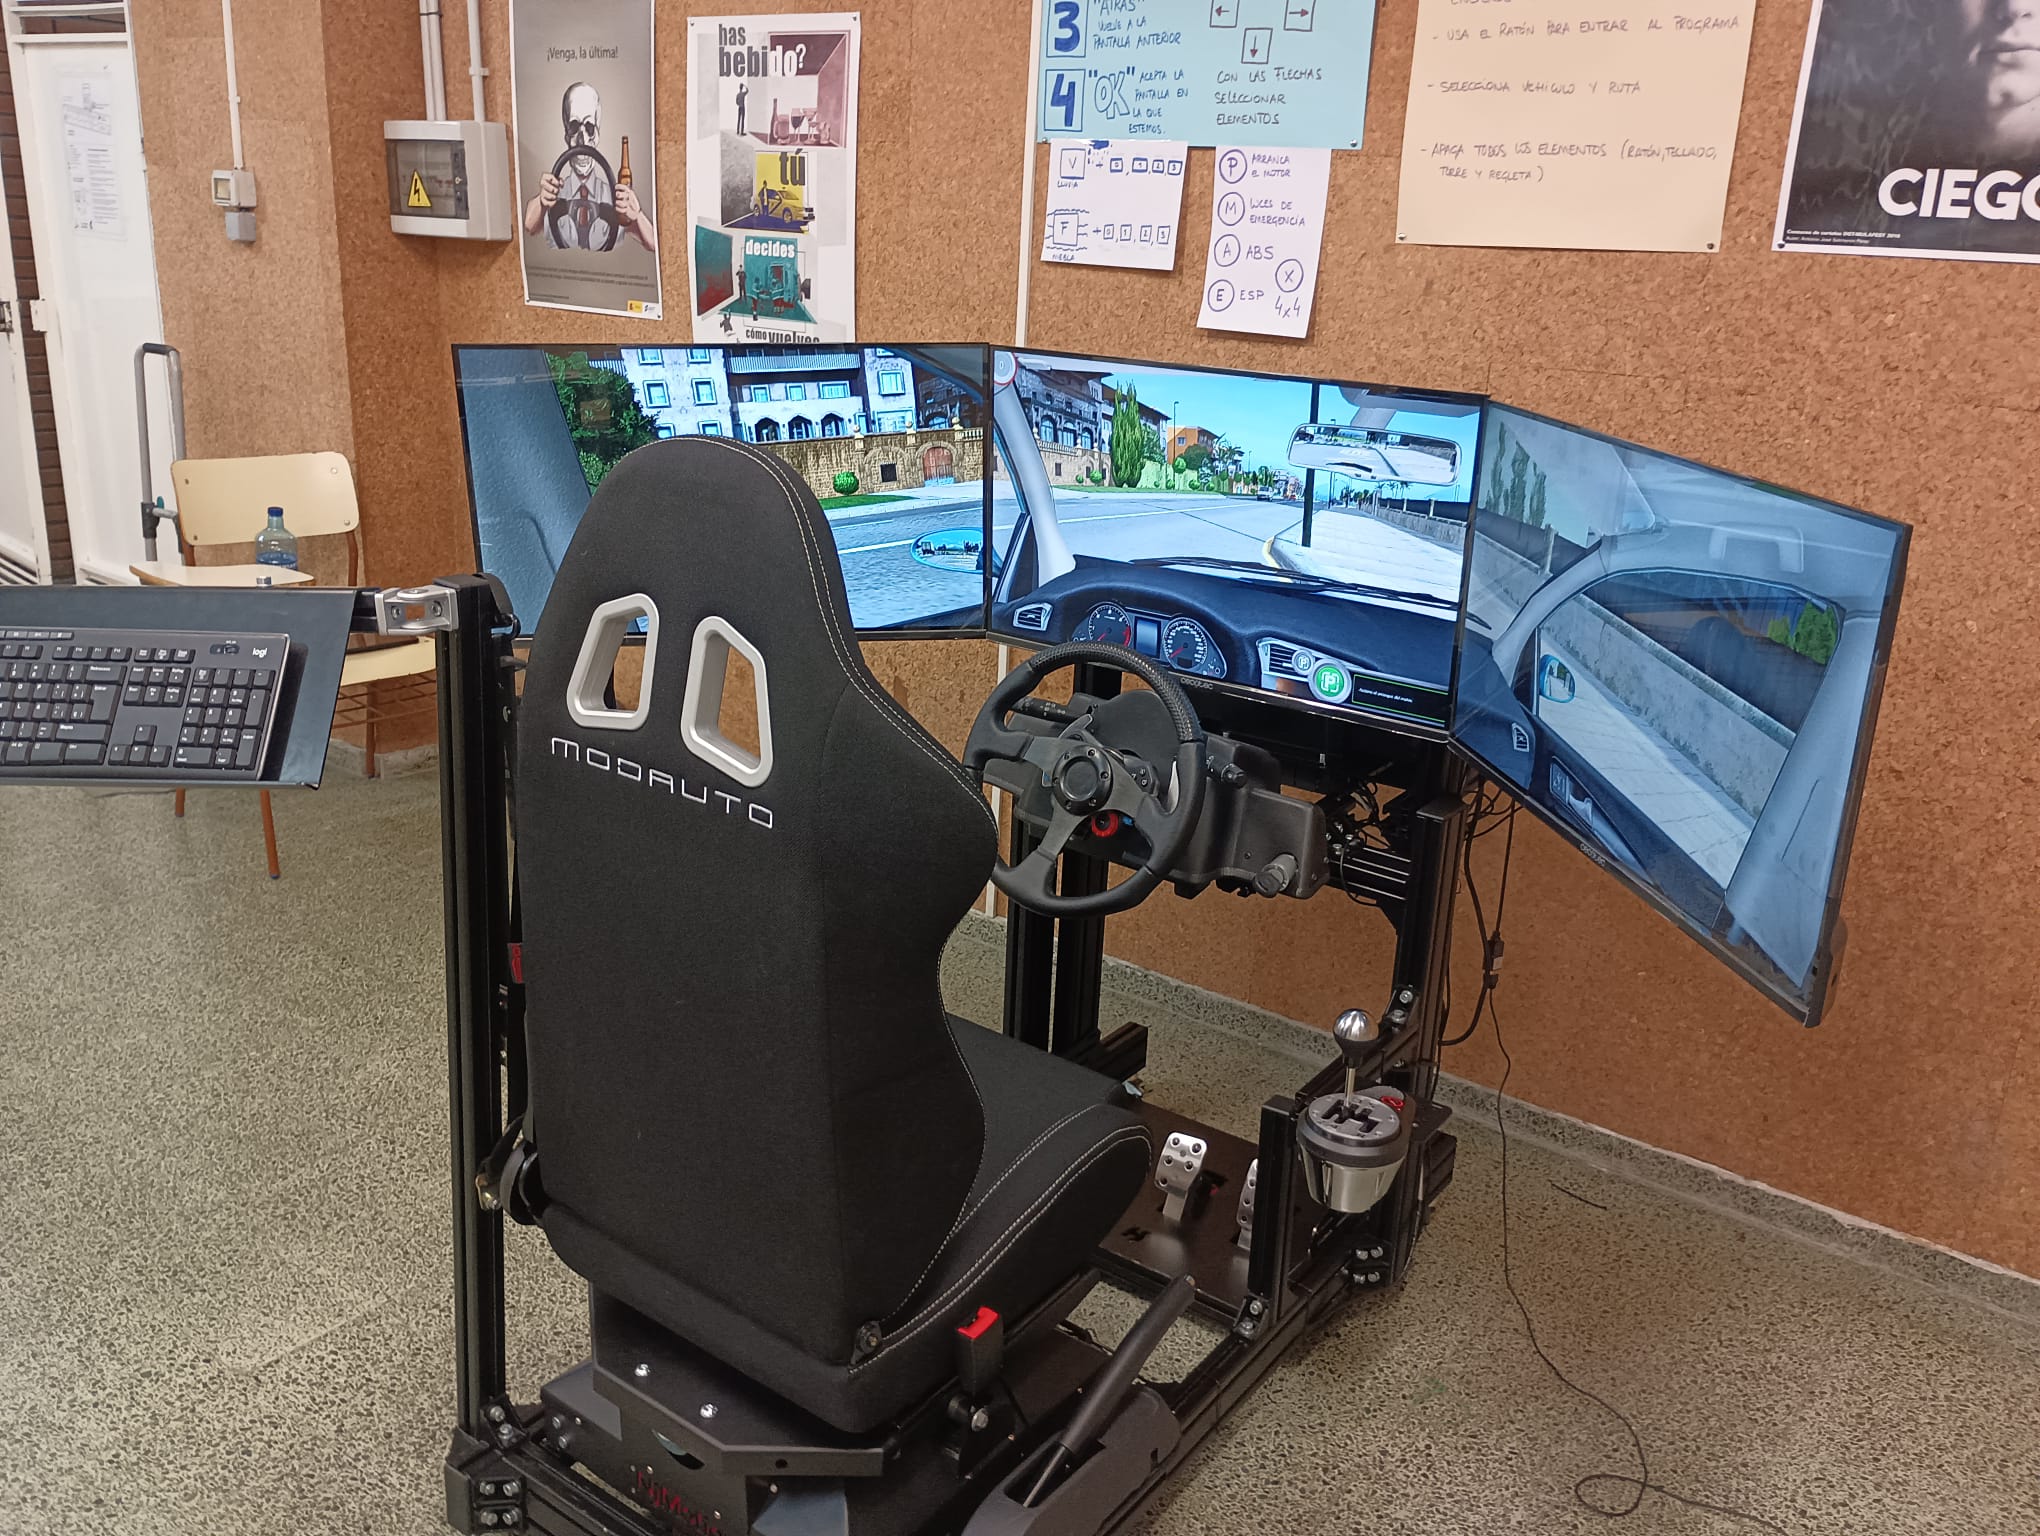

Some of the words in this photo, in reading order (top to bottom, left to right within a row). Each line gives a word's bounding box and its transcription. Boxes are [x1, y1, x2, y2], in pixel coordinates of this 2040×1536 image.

[1054, 1, 1080, 52] 3
[1127, 22, 1133, 31] A
[1136, 16, 1146, 27] LA
[1447, 29, 1469, 41] USA
[1500, 22, 1534, 36] RATÓN
[1579, 20, 1629, 33] ENTRAR
[1648, 19, 1663, 30] AL
[1674, 16, 1739, 33] PROGRAMA
[719, 24, 746, 46] has
[1093, 34, 1131, 50] PANTALLA
[1136, 32, 1181, 48] ANTERIOR
[547, 48, 577, 62] ¡Venga,
[579, 46, 587, 58] la
[589, 46, 618, 59] última!
[719, 44, 807, 77] bebido?
[1217, 70, 1238, 84] CON
[1249, 71, 1266, 83] LAS
[1274, 67, 1322, 81] FLECHAS
[1134, 89, 1170, 100] PANTALLA
[1177, 88, 1188, 98] EN
[1589, 81, 1598, 94] Y
[1608, 81, 1641, 94] RUTA
[1050, 73, 1076, 127] 4
[1139, 70, 1167, 83] ACEPTA
[1174, 69, 1184, 80] LA
[1214, 91, 1287, 105] SELECCIONAR
[1132, 107, 1142, 117] LA
[1146, 108, 1162, 117] QUE
[1216, 112, 1280, 126] ELEMENTOS
[1431, 142, 1464, 160] APAGA
[1474, 144, 1507, 158] TODOS
[1515, 142, 1532, 155] LOS
[1538, 142, 1607, 157] ELEMENTOS
[779, 148, 806, 186] tú
[1440, 166, 1468, 179] TORRE
[1281, 201, 1293, 210] DE
[745, 239, 796, 259] decides
[1246, 246, 1274, 260] ABS
[1239, 289, 1265, 301] ESP
[745, 327, 767, 341] cómo
[252, 647, 268, 658] logi
